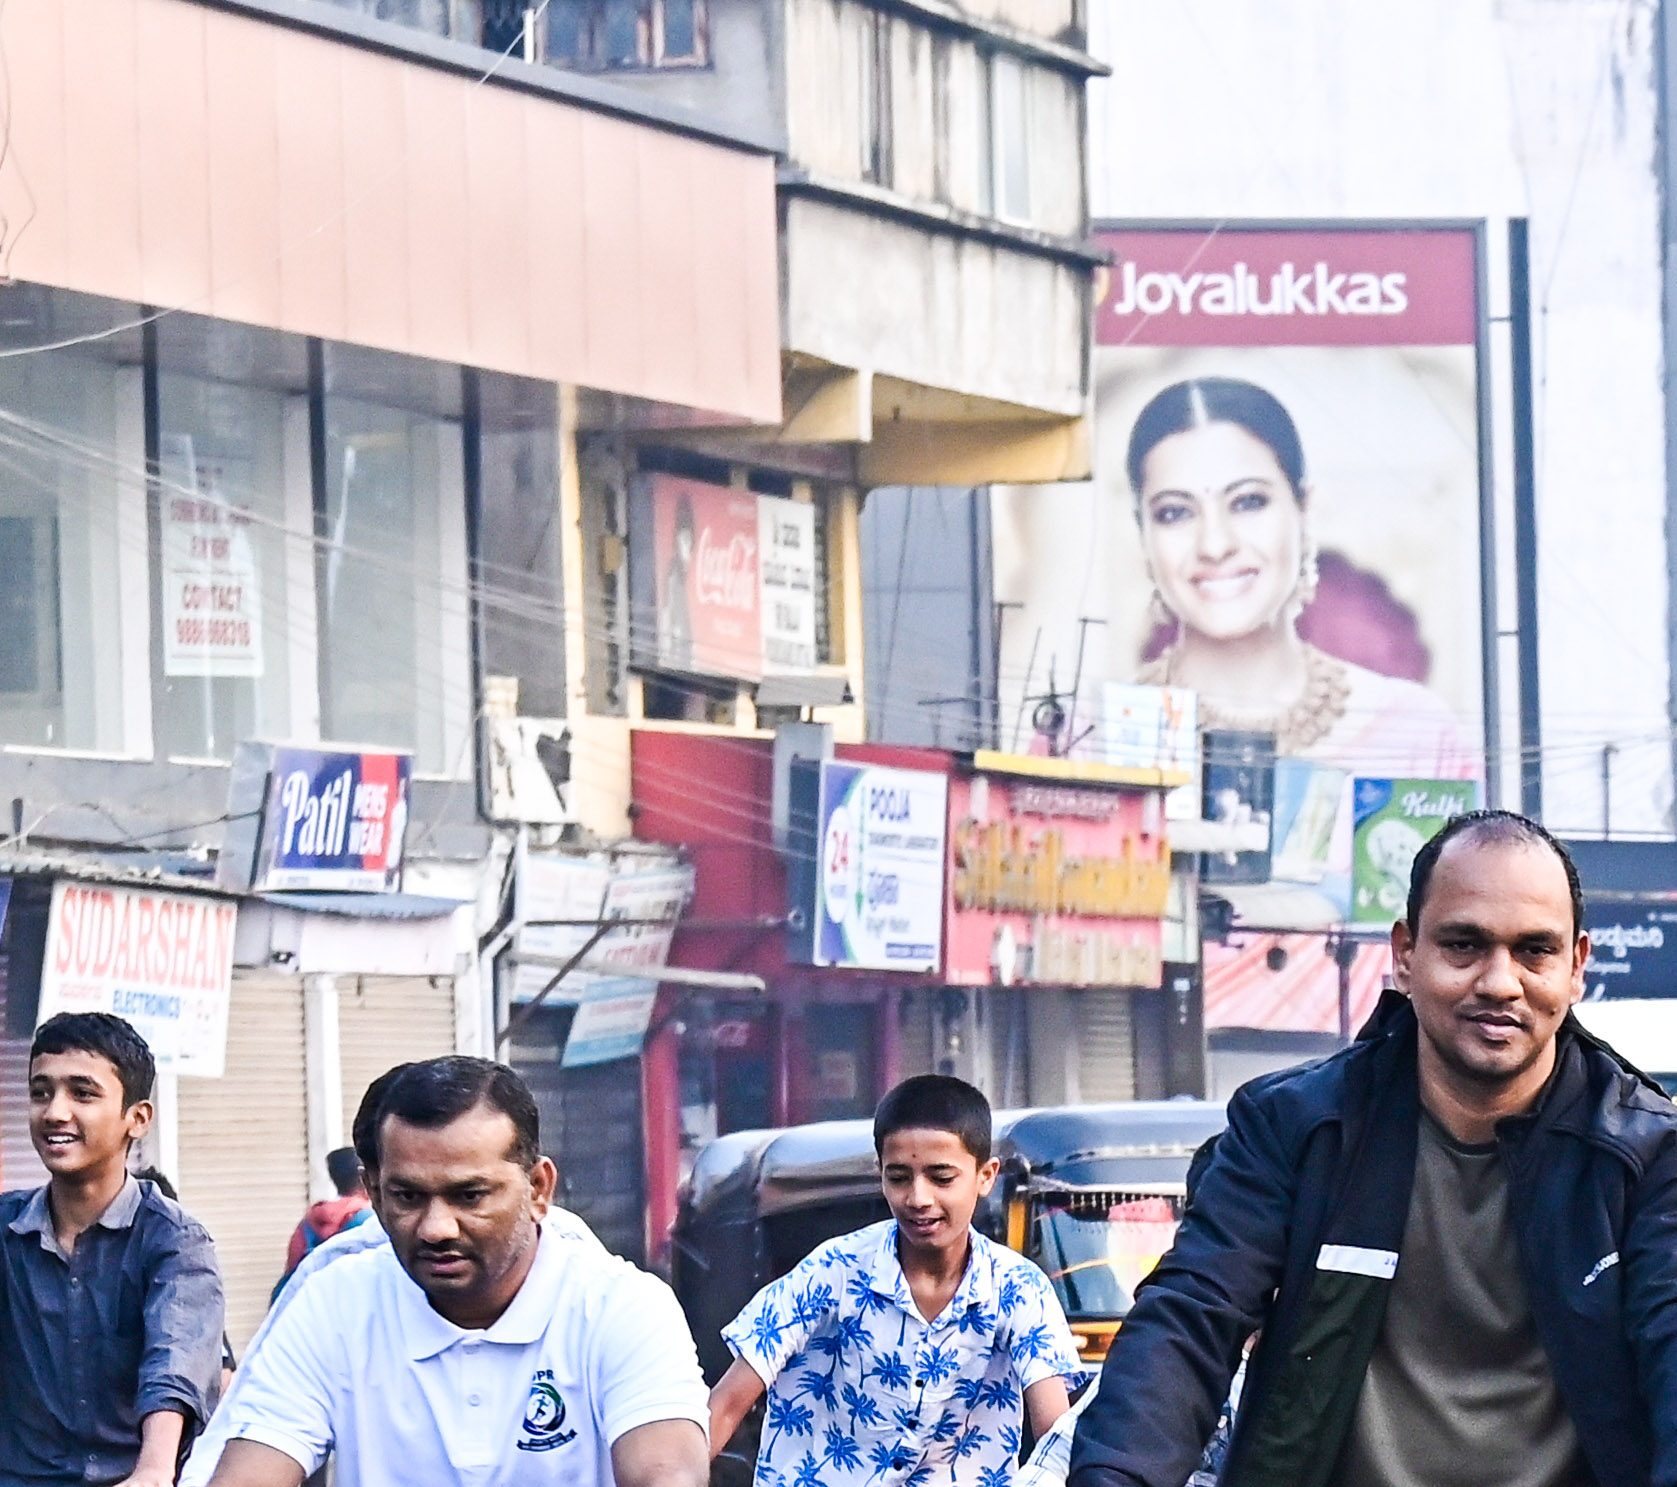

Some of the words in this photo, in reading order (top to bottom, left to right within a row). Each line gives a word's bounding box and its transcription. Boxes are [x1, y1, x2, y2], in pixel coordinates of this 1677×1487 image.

[1114, 262, 1408, 317] Joyalukkas
[281, 768, 353, 857] Patil
[353, 783, 390, 819] MENS
[869, 786, 911, 822] POOJA
[1402, 790, 1465, 821] Kulfi
[348, 820, 385, 856] WEAR
[830, 829, 849, 874] 24
[55, 884, 235, 991] SUDARSHAN
[112, 989, 180, 1019] ELECTRONICS
